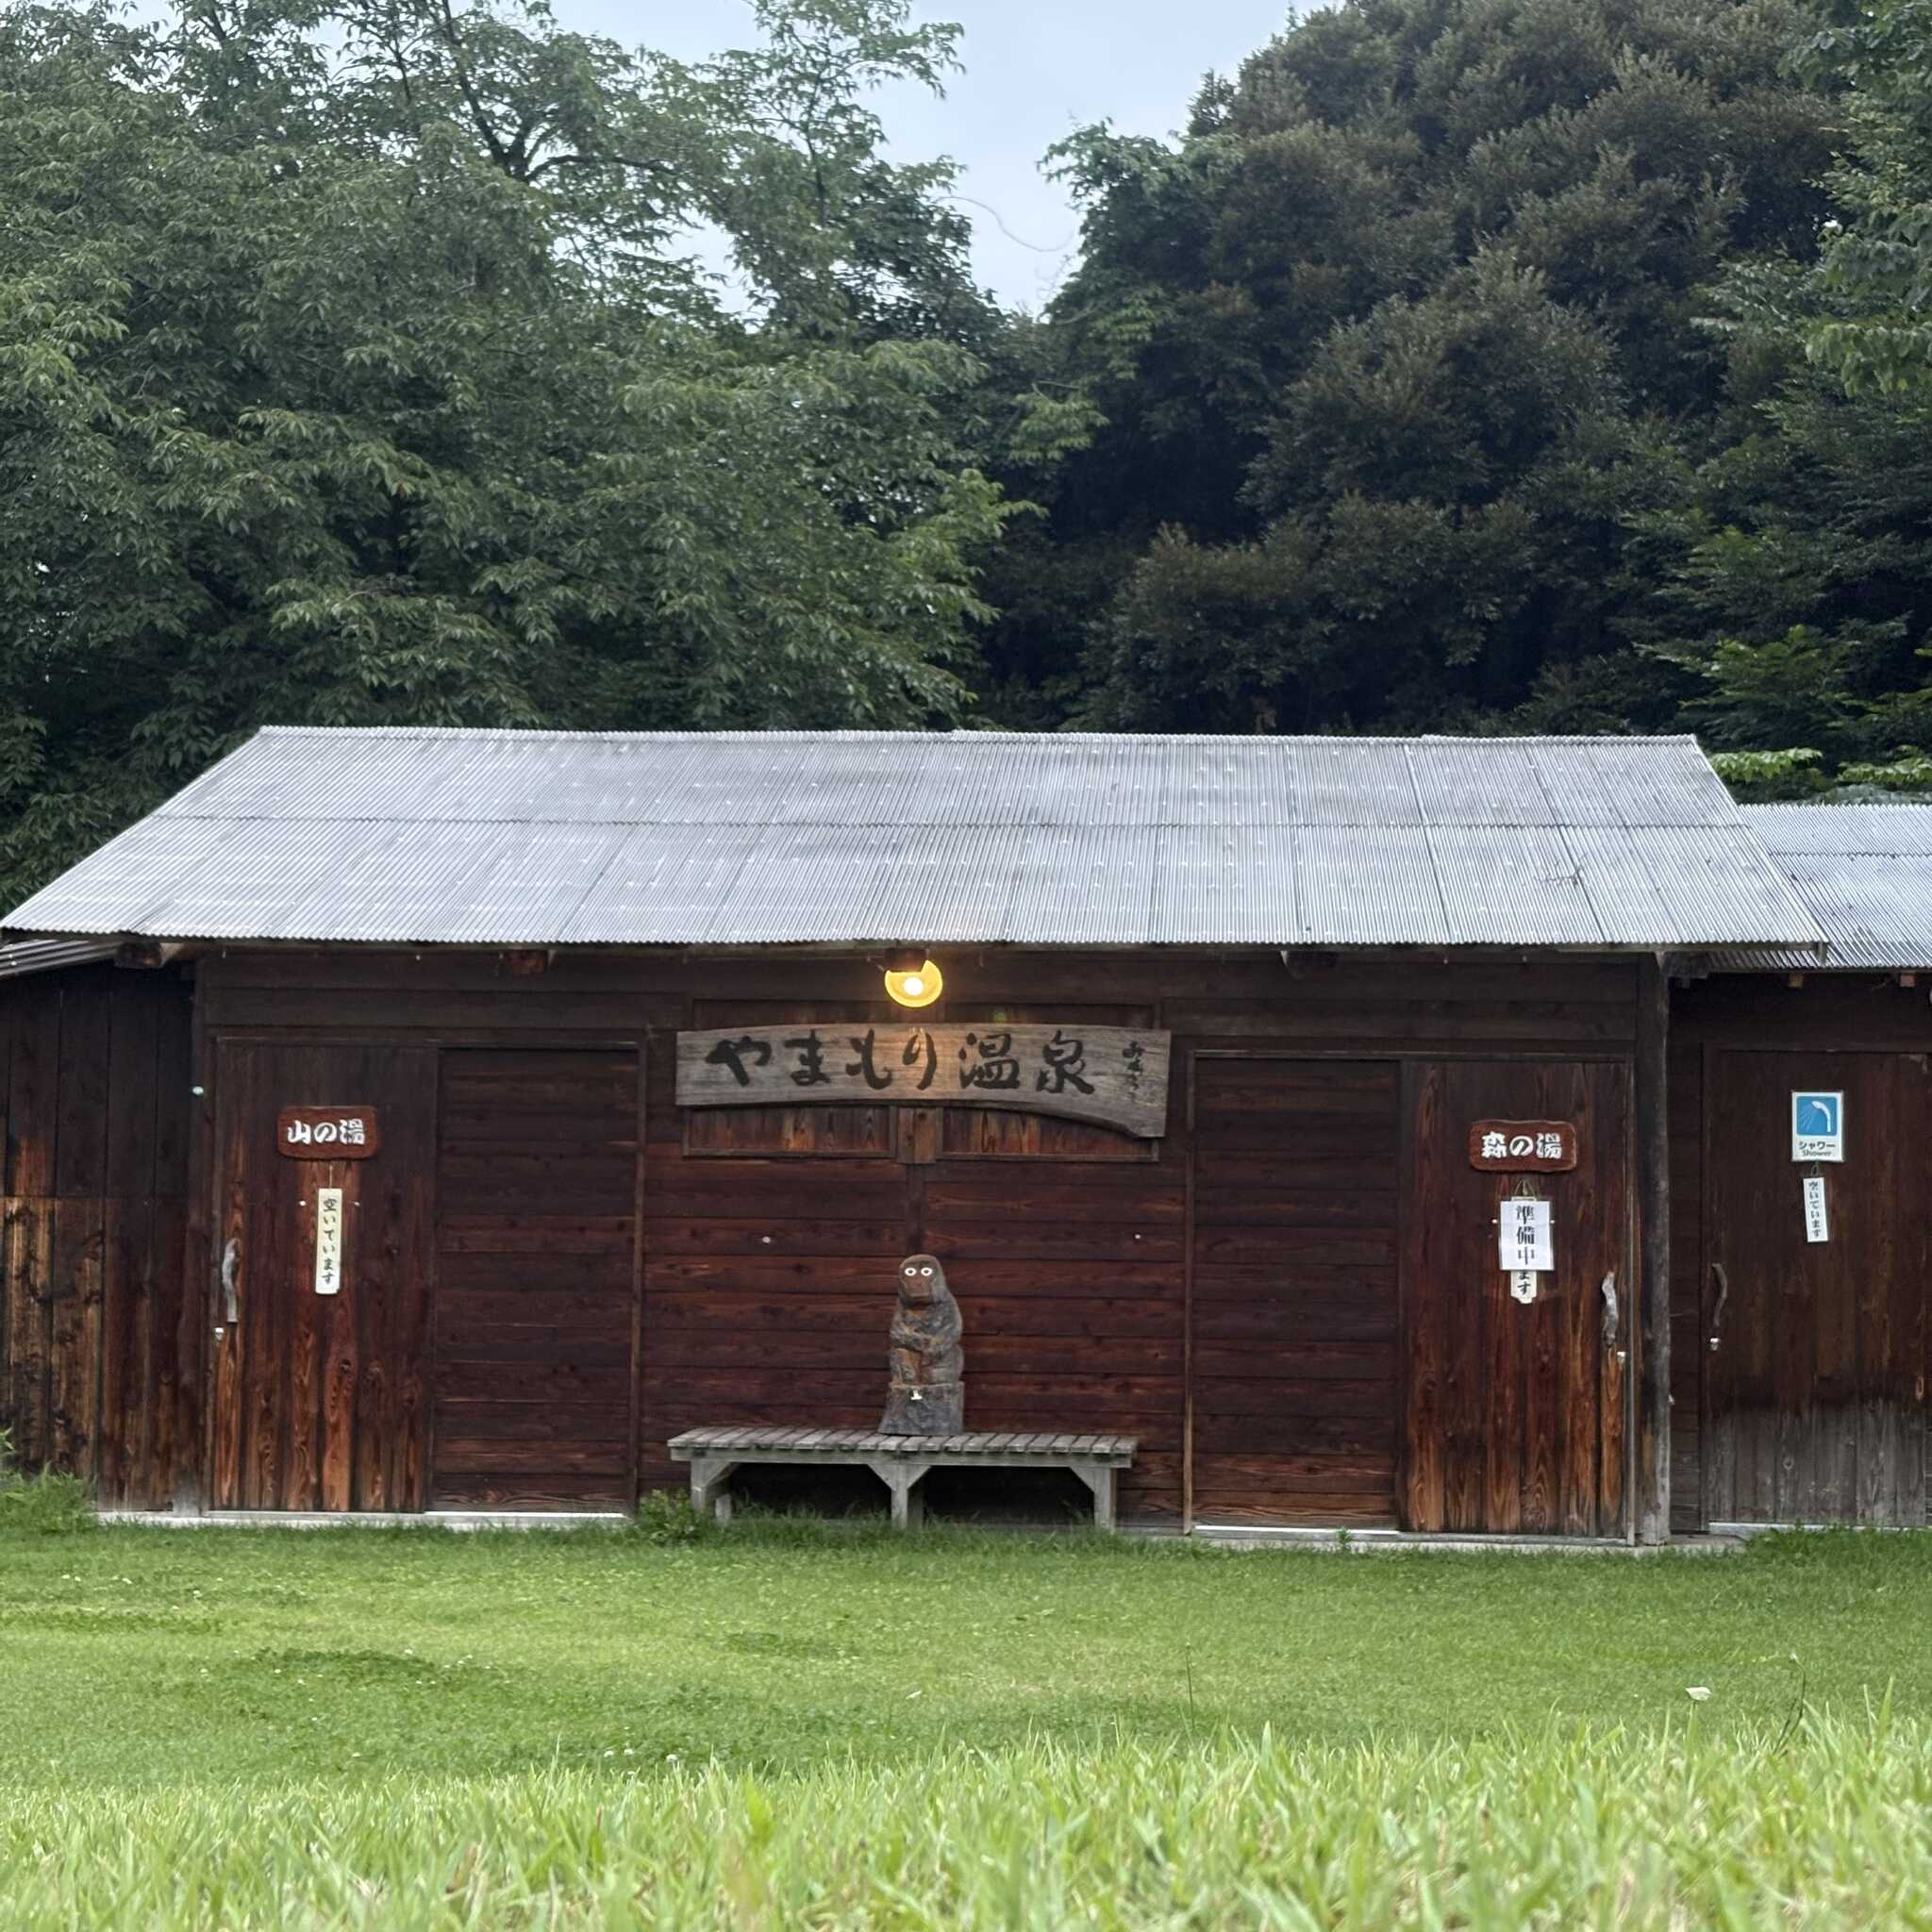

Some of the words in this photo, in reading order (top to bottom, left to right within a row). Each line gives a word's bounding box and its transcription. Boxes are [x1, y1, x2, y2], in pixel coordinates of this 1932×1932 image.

[707, 1029, 1095, 1094] やまもり温泉
[287, 1119, 366, 1145] 山の湯
[1480, 1131, 1563, 1159] 森の湯
[1798, 1141, 1836, 1150] シャワー
[321, 1198, 338, 1285] 空いています
[1516, 1205, 1535, 1266] 準備中
